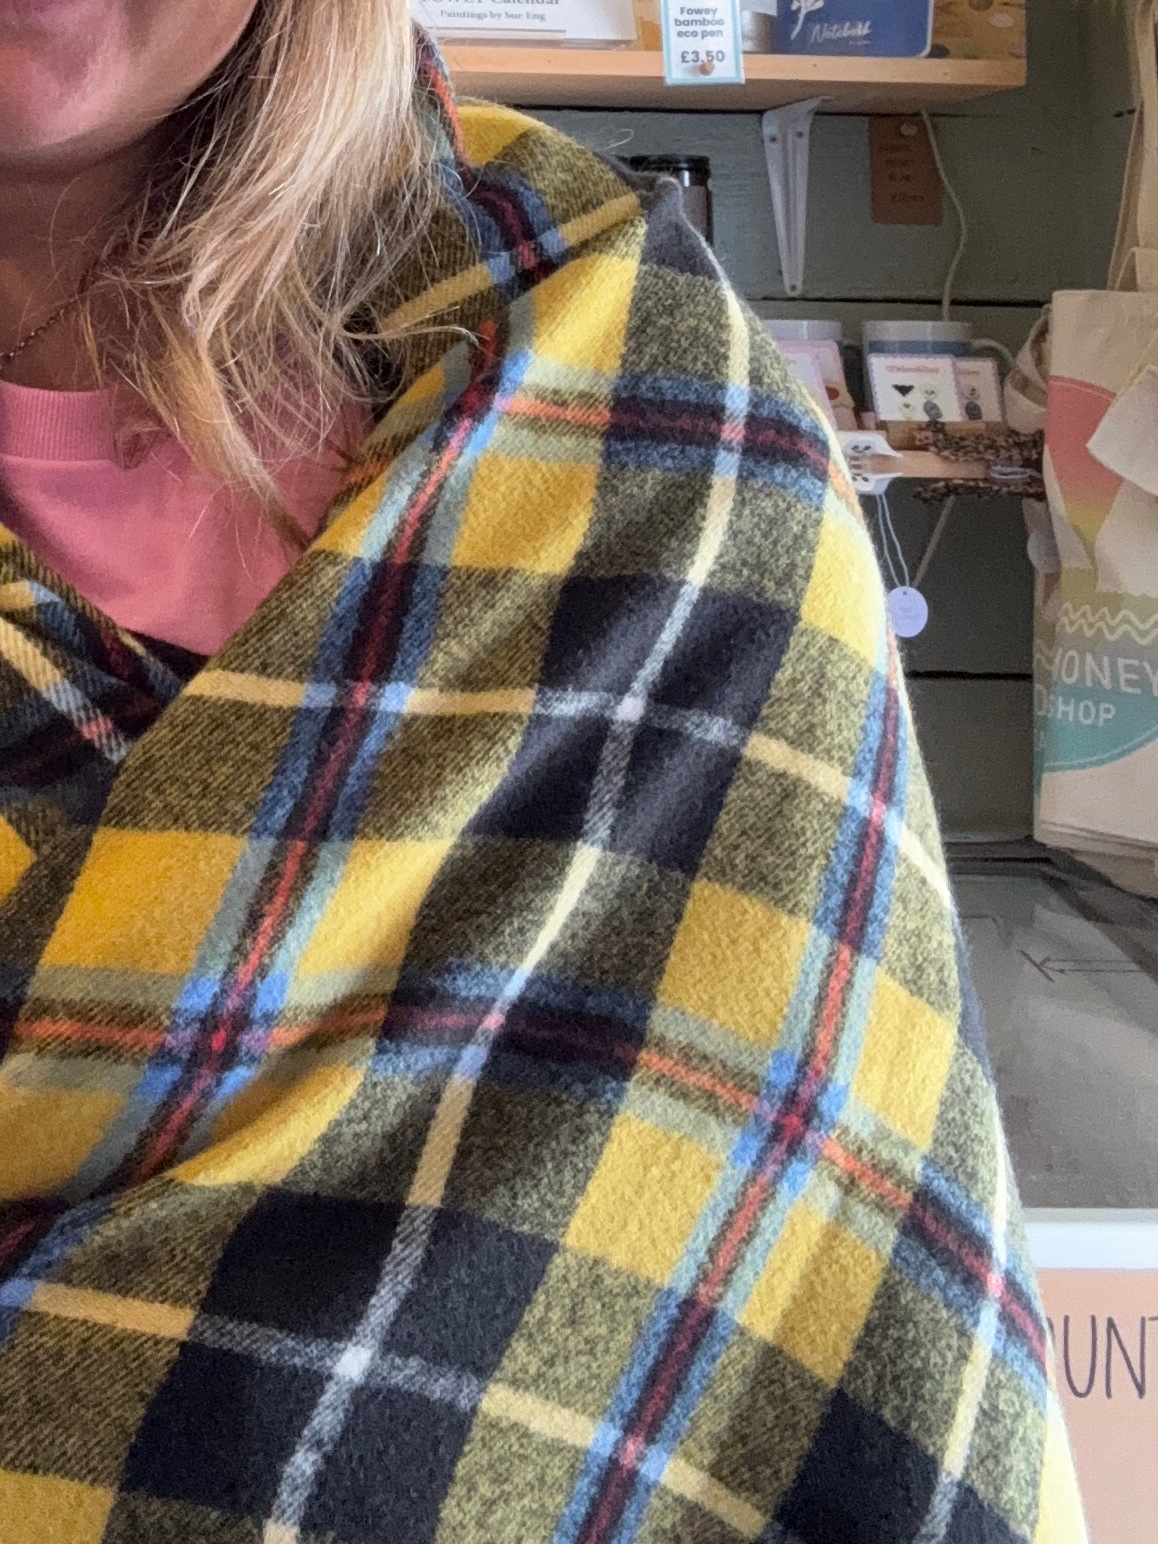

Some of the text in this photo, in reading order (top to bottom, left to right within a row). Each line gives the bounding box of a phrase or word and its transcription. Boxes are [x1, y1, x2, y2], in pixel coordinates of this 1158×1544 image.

[440, 9, 488, 20] Paintings
[490, 10, 502, 21] by
[504, 11, 523, 20] Sue
[679, 6, 718, 16] Fowey
[674, 18, 724, 27] bamboo
[676, 30, 724, 40] eco pen
[680, 50, 726, 64] £3.50
